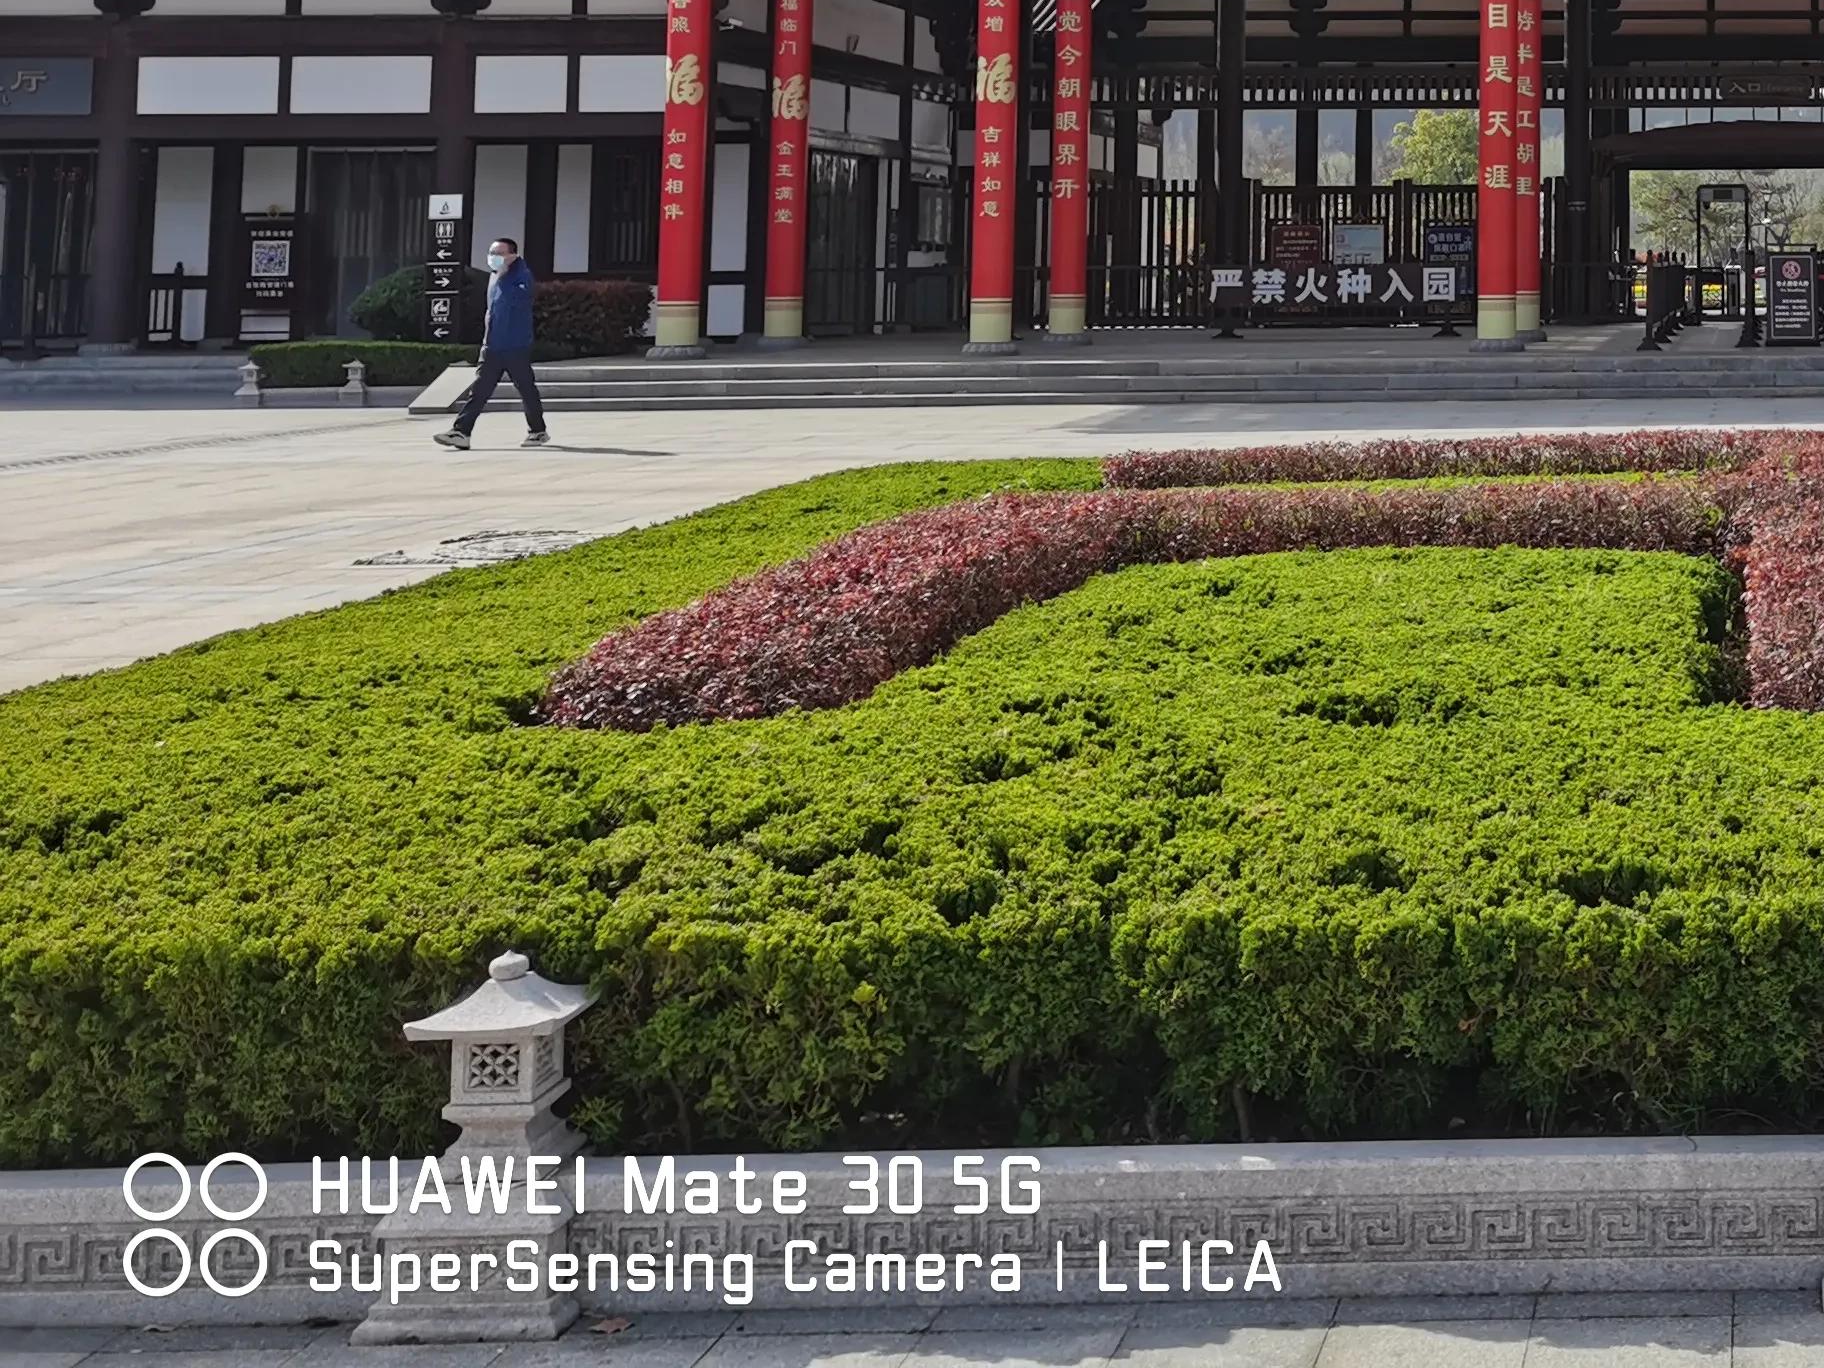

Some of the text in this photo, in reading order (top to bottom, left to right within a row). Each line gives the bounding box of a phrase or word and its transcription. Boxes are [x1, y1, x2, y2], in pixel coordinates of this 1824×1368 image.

[0, 70, 48, 92] 厅
[976, 52, 1016, 104] 福
[1728, 81, 1761, 94] 入口
[662, 128, 687, 222] 如意相伴
[774, 140, 796, 224] 金玉满堂
[979, 126, 1002, 218] 吉祥如意
[1208, 266, 1457, 305] 严禁火种入园
